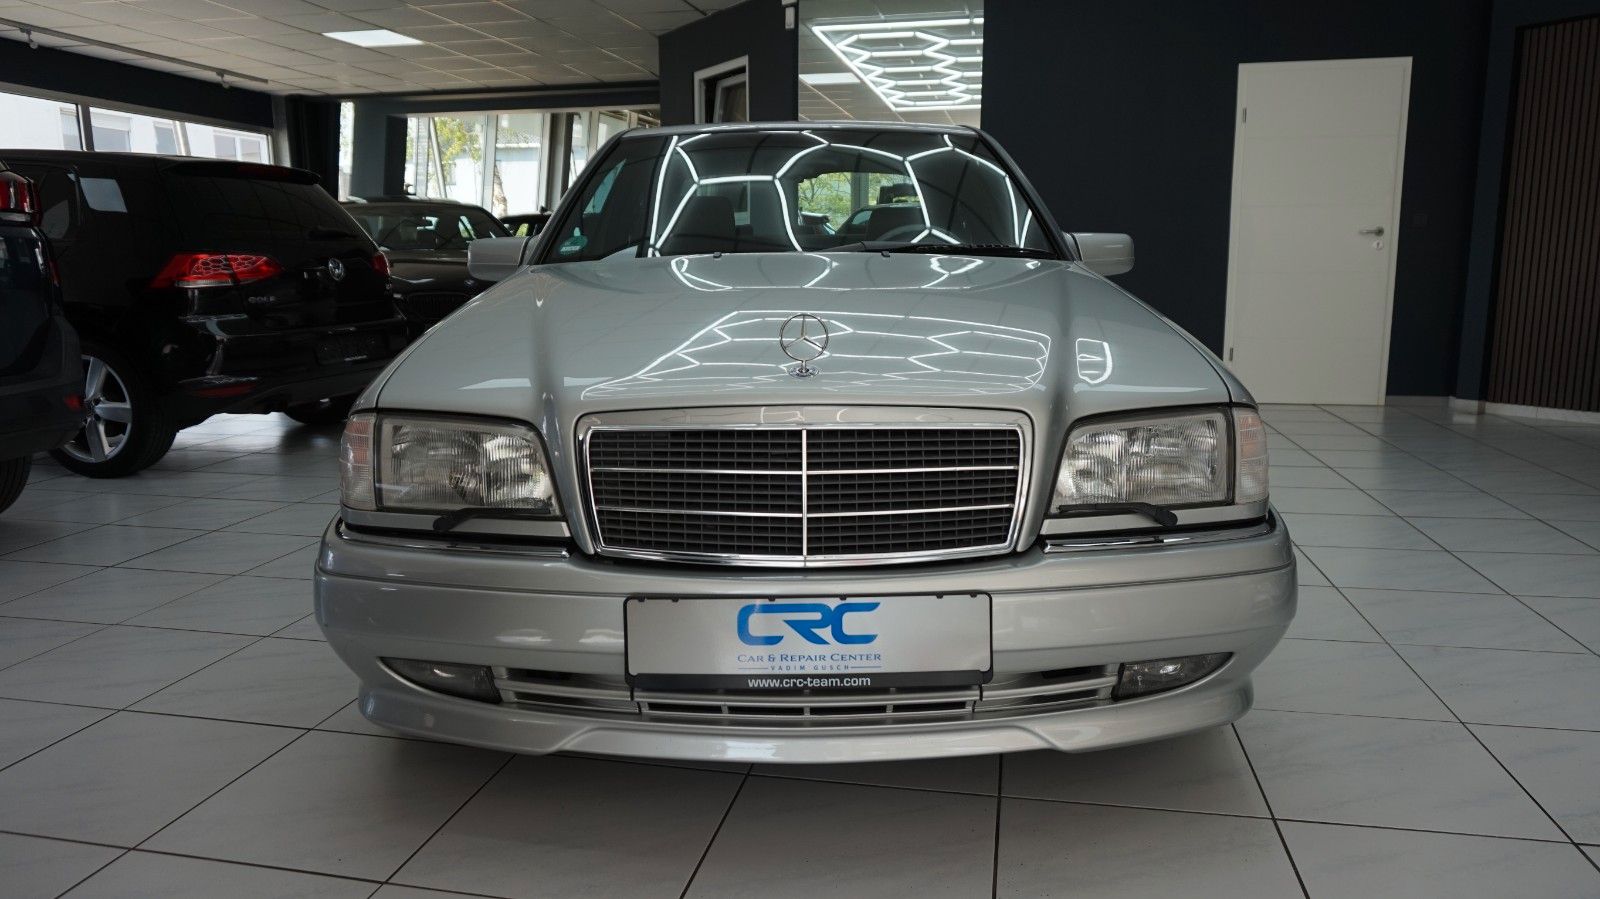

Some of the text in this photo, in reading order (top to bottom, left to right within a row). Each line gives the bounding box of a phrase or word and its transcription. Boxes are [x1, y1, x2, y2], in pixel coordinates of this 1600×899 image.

[736, 602, 881, 646] CRC
[767, 654, 776, 662] &
[748, 677, 871, 688] www.crc-team.com
